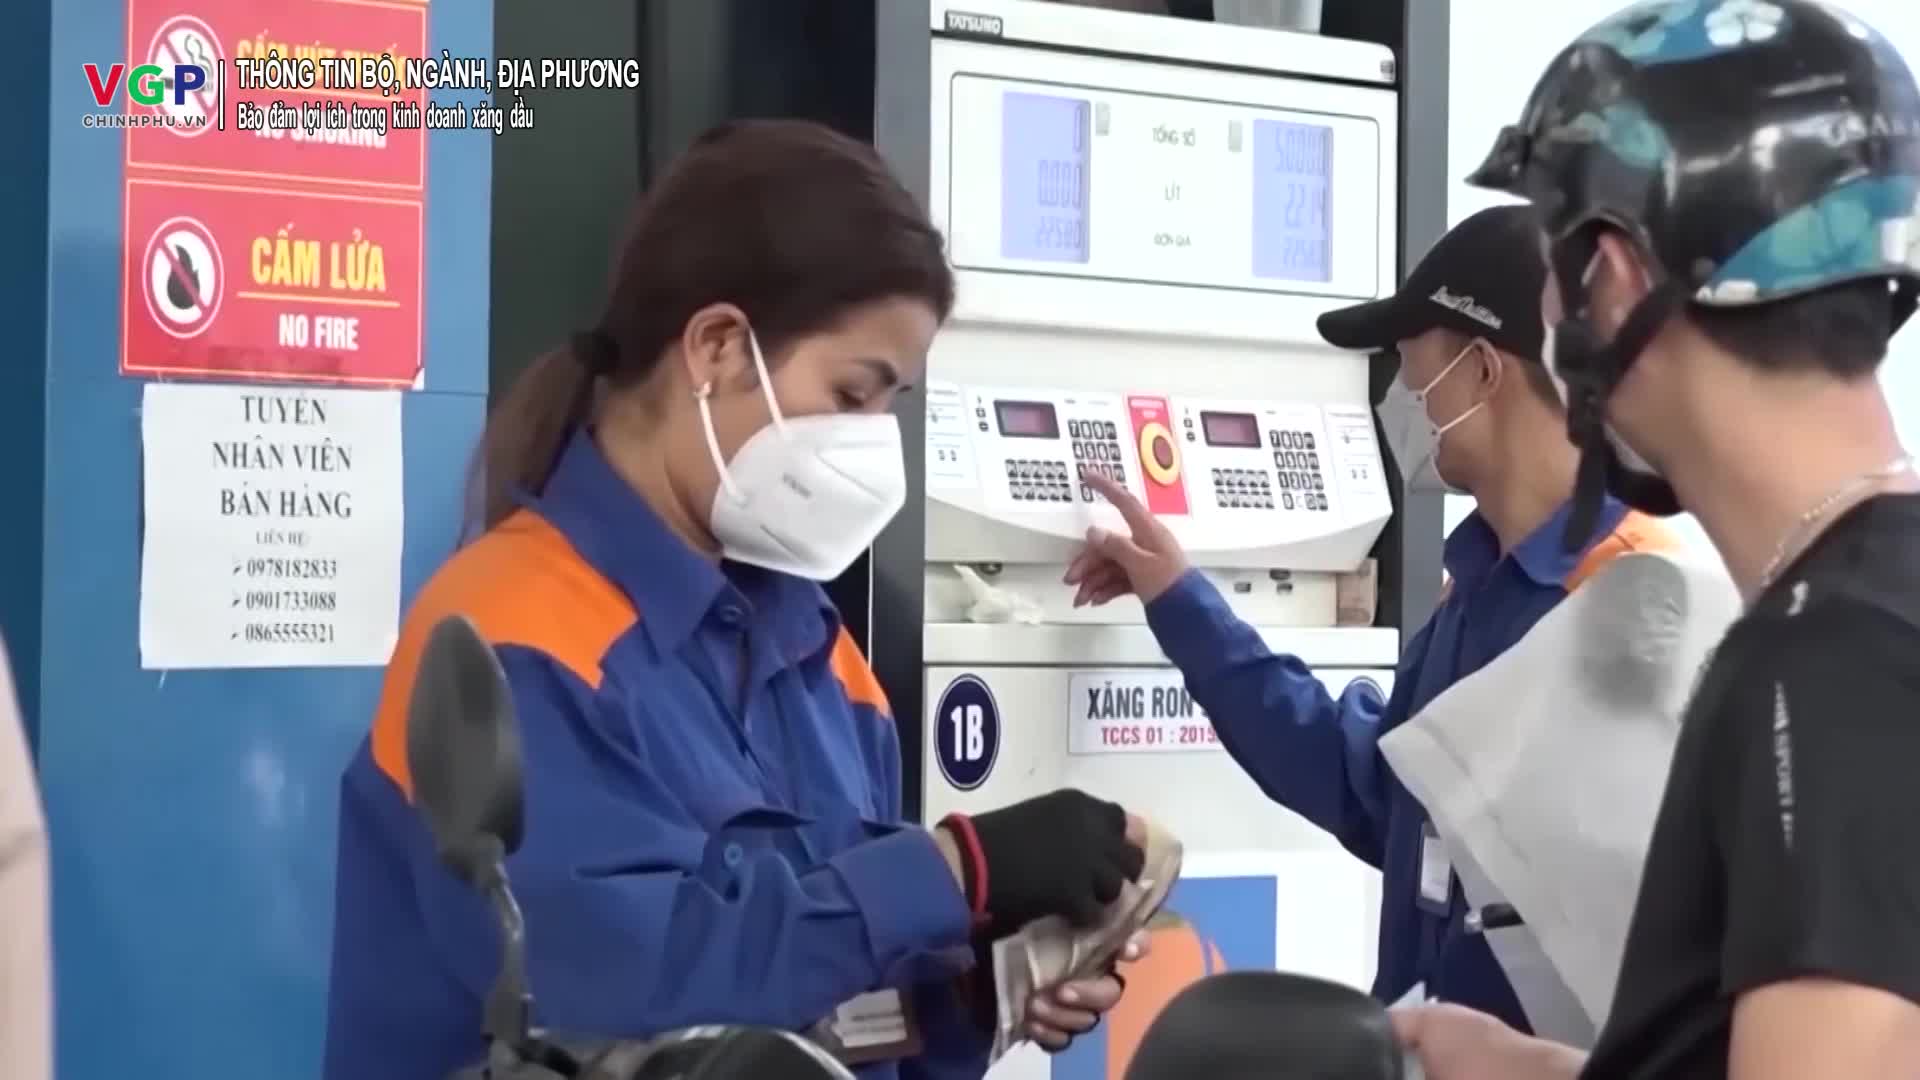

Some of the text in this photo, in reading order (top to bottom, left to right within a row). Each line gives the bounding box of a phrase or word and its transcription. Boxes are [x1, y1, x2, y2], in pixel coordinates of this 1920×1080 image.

[252, 221, 387, 292] CẤM LỬA
[278, 313, 360, 350] NO FIRE
[212, 434, 352, 472] NHÂN VIÊN
[221, 481, 352, 518] BÁN HÀNG
[246, 558, 337, 578] 0978182833
[245, 591, 336, 610] 0901733088
[245, 623, 334, 643] 0865555321
[1087, 681, 1193, 720] XĂNG RON
[950, 704, 984, 761] 1B
[1101, 725, 1141, 745] TCCS
[1146, 726, 1163, 744] 01
